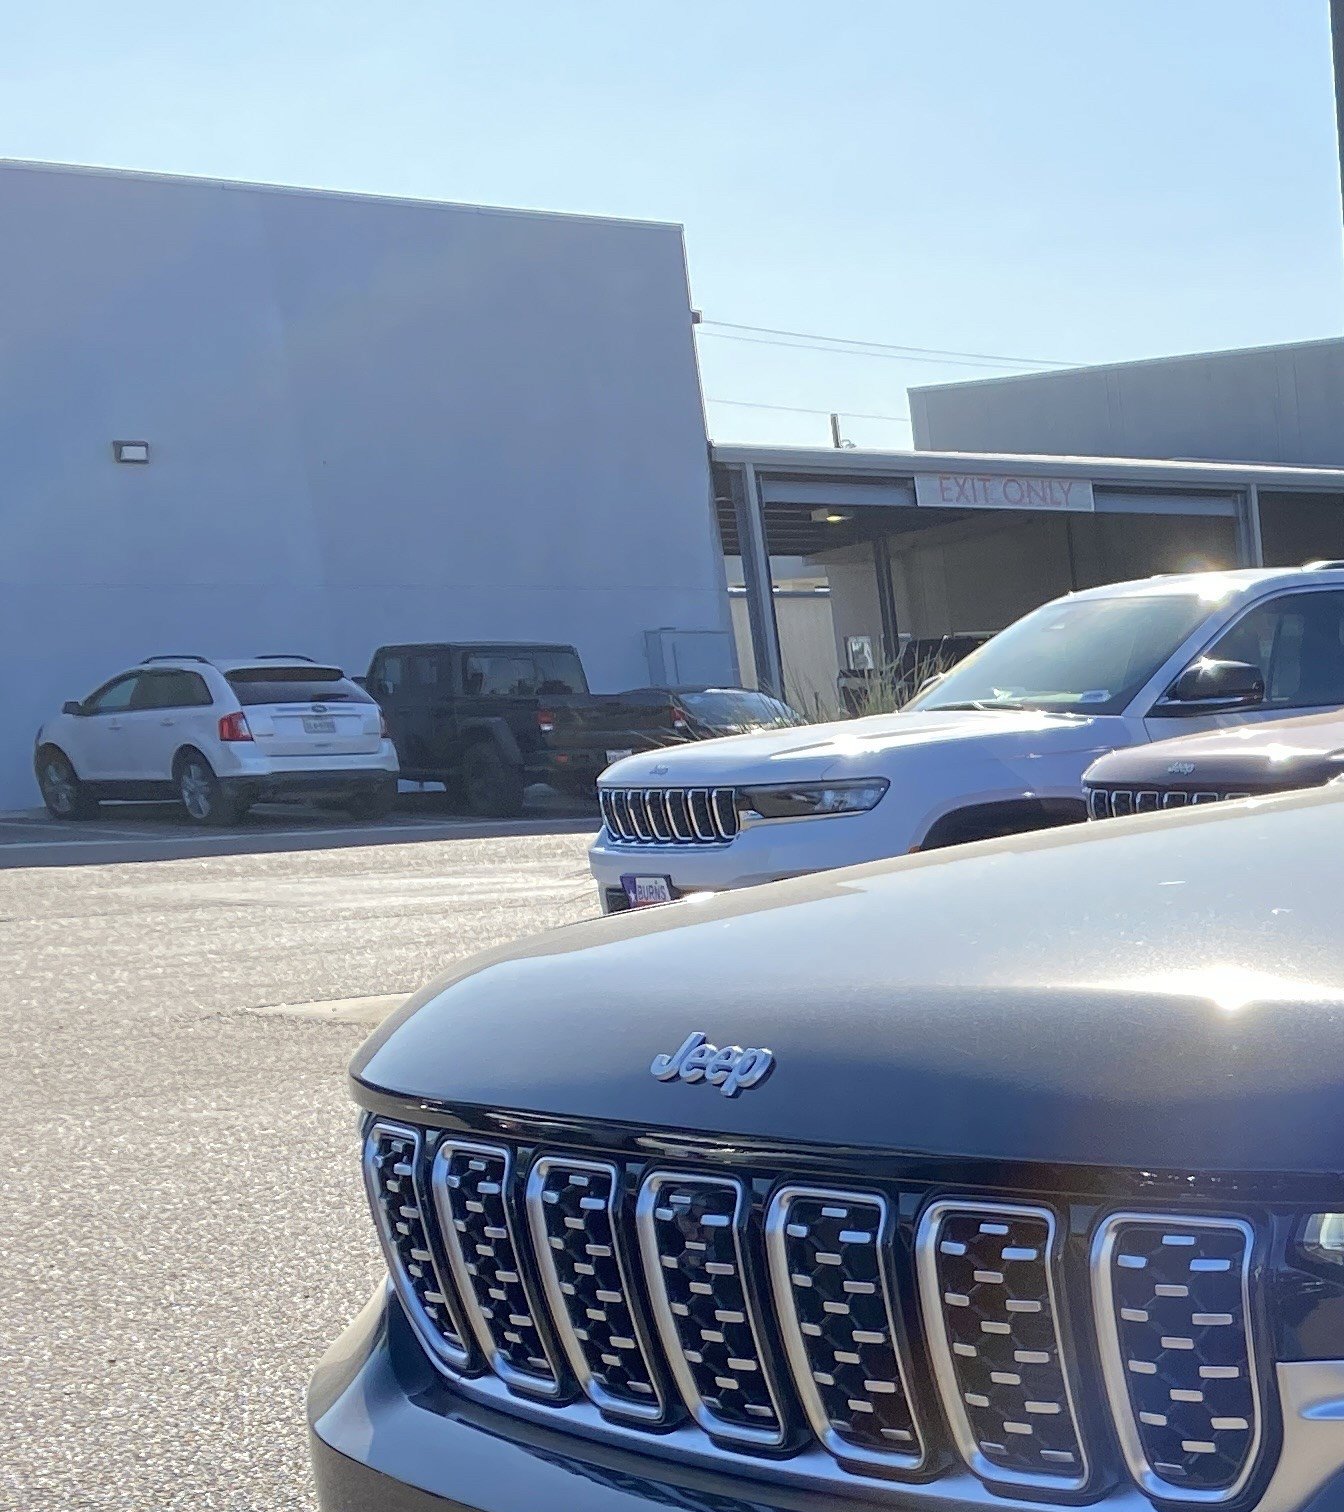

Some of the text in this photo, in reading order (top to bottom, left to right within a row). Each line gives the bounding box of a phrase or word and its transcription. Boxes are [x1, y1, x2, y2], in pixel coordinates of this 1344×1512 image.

[939, 475, 1073, 507] EXIT ONLY
[637, 884, 668, 901] BURNS
[651, 1031, 773, 1097] Jeep
